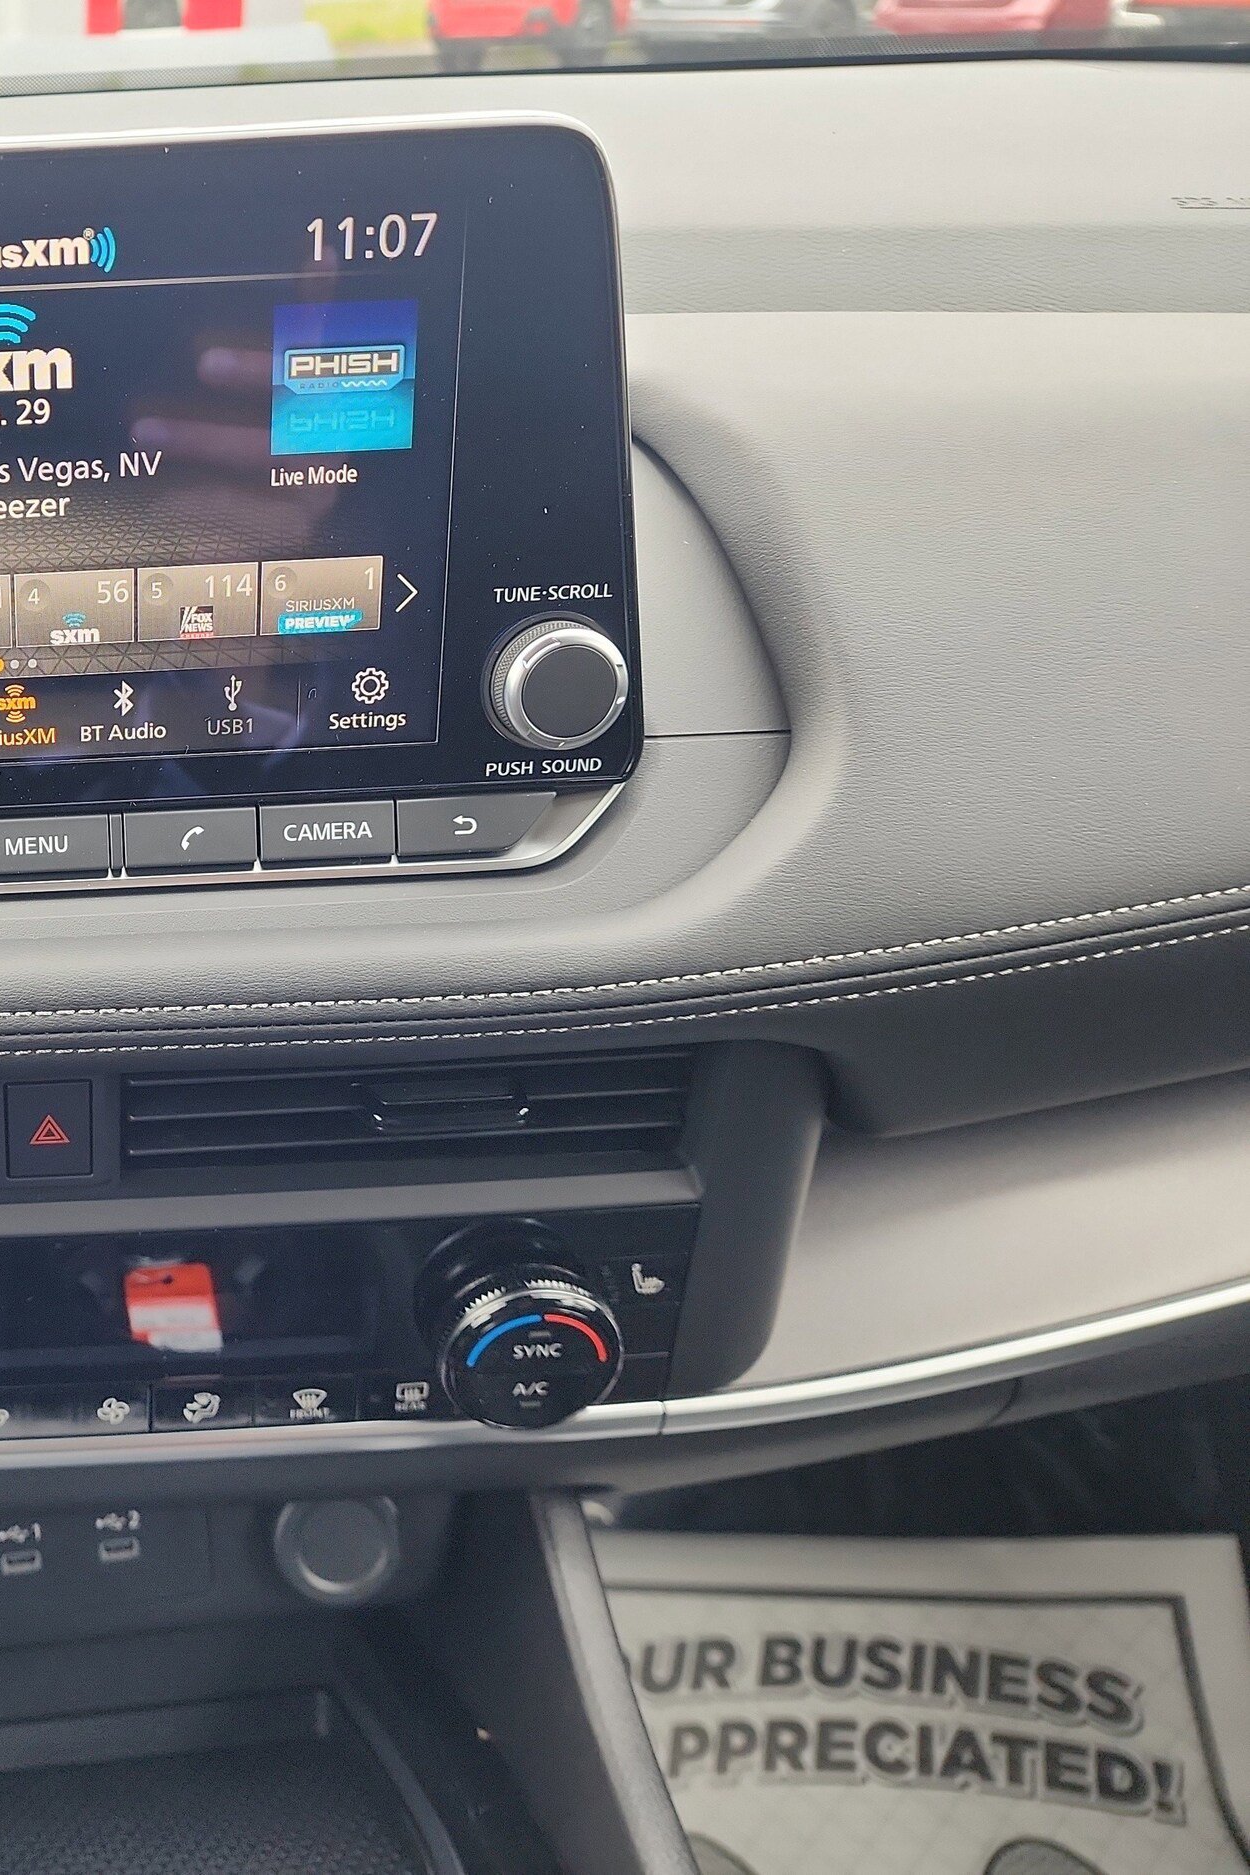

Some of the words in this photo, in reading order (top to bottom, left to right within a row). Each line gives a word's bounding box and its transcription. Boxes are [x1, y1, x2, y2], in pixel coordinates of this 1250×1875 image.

[306, 212, 438, 261] 11:07
[291, 352, 398, 377] PHISH
[299, 381, 339, 390] RADIO
[15, 398, 51, 426] 29
[17, 456, 110, 487] Vegas,
[119, 451, 162, 478] NV
[270, 467, 304, 487] Live
[307, 463, 358, 484] Mode
[205, 573, 253, 599] 114
[274, 574, 287, 592] 6
[364, 566, 374, 590] 1
[27, 587, 40, 605] 4
[97, 579, 130, 604] 56
[151, 581, 162, 599] 5
[285, 597, 355, 612] SIRIUSXM
[184, 622, 214, 633] NEWS
[190, 612, 214, 624] FOX
[285, 614, 356, 630] PREVIEW
[50, 628, 100, 646] sxm
[80, 725, 105, 742] BT
[108, 722, 167, 741] Audio
[208, 718, 254, 736] USB1
[328, 711, 407, 734] Settings
[485, 761, 534, 777] PUSH
[541, 757, 602, 775] SOUND
[283, 821, 373, 842] CAMERA
[4, 836, 69, 856] MENU
[512, 1342, 564, 1360] SYNC
[511, 1381, 549, 1397] A/C
[758, 1634, 1137, 1724] BUSINESS
